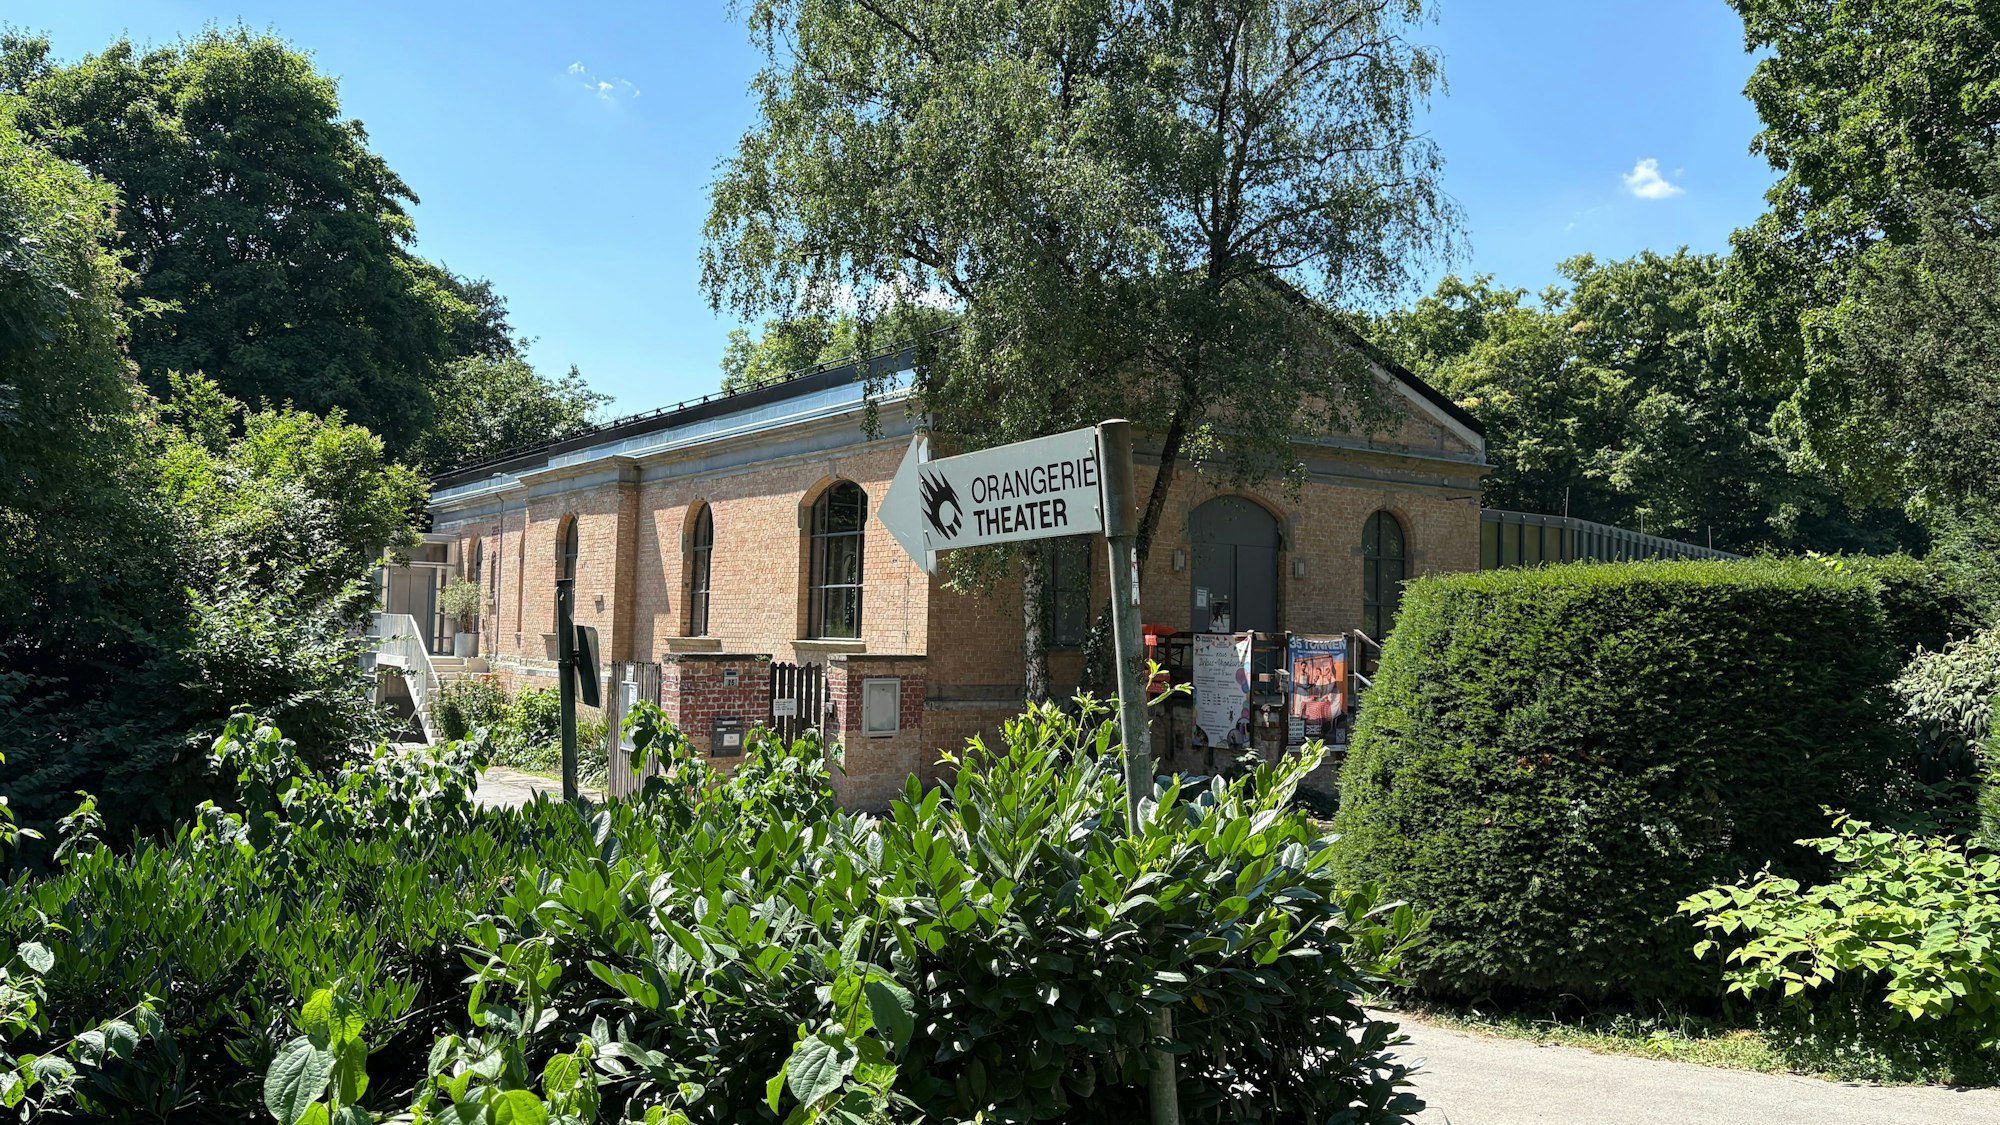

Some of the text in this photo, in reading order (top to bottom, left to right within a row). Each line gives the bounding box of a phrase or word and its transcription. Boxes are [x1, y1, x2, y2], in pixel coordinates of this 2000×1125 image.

[971, 456, 1097, 504] ORANGERIE
[973, 498, 1068, 537] THEATER
[1289, 637, 1347, 650] 35 TONNEN
